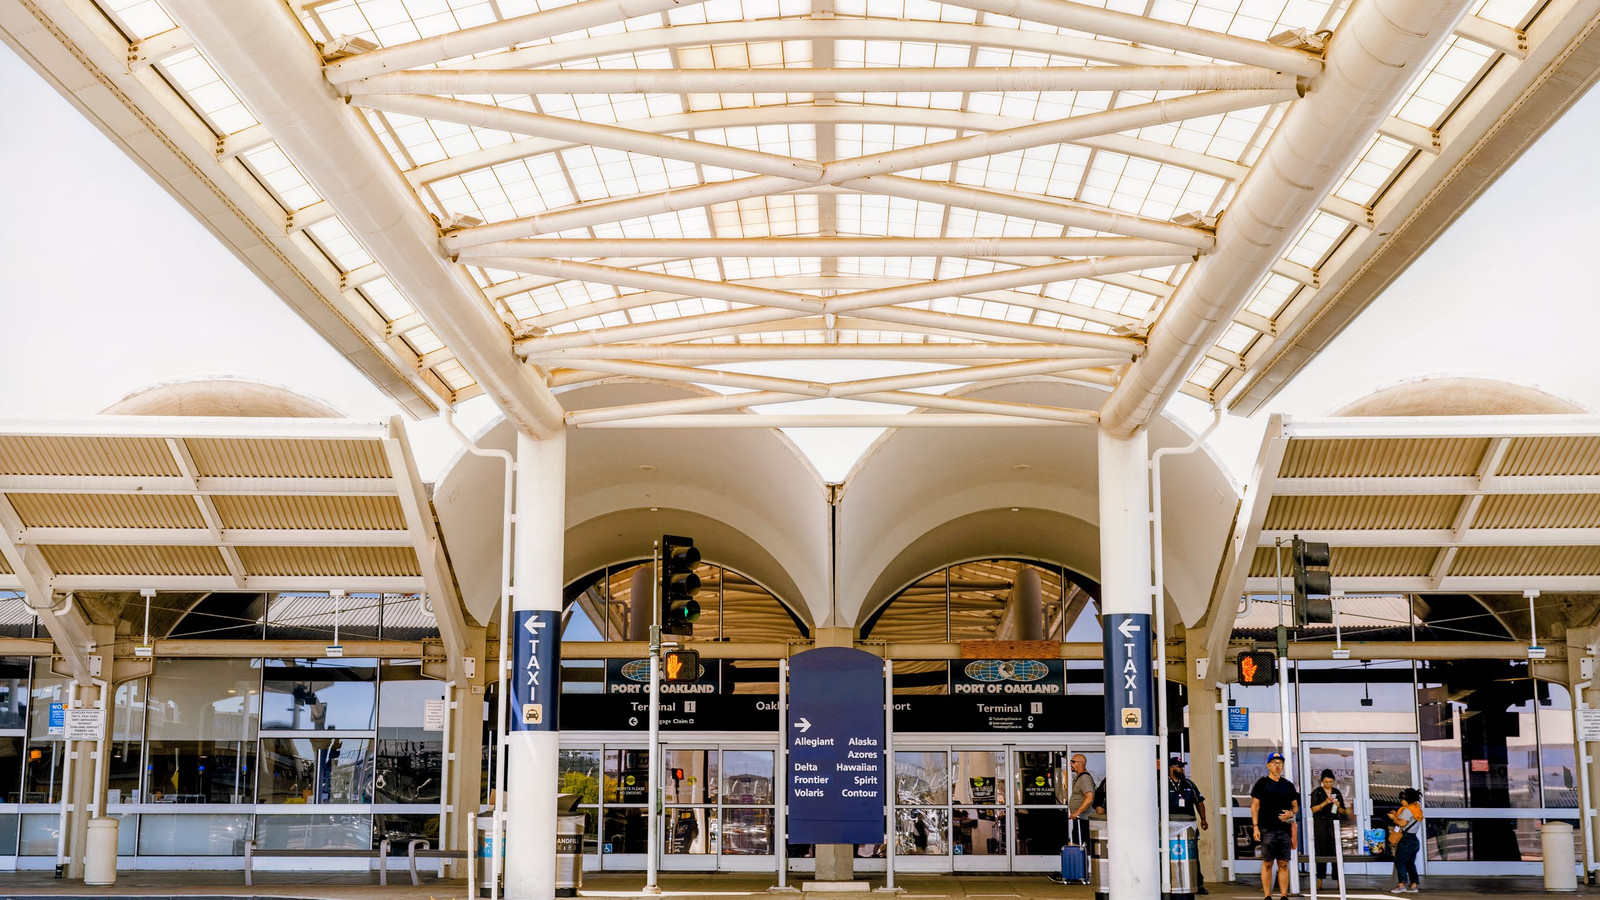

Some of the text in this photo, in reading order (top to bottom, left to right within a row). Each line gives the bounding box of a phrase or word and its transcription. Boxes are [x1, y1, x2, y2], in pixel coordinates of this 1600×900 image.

[526, 640, 540, 700] TAXI
[1124, 644, 1138, 705] TAXI
[611, 684, 641, 694] PORT
[660, 684, 714, 694] OAKLAND
[954, 684, 1060, 694] PORT OF OAKLAND
[630, 702, 676, 712] Terinal
[977, 704, 1022, 712] Terminal
[794, 738, 834, 747] Allegiant
[848, 738, 877, 746] Alaska
[848, 750, 877, 758] Azores
[836, 763, 877, 771] Hawaiian
[854, 776, 878, 786] Spirit
[794, 789, 824, 797] Volaris
[842, 789, 878, 797] Contour
